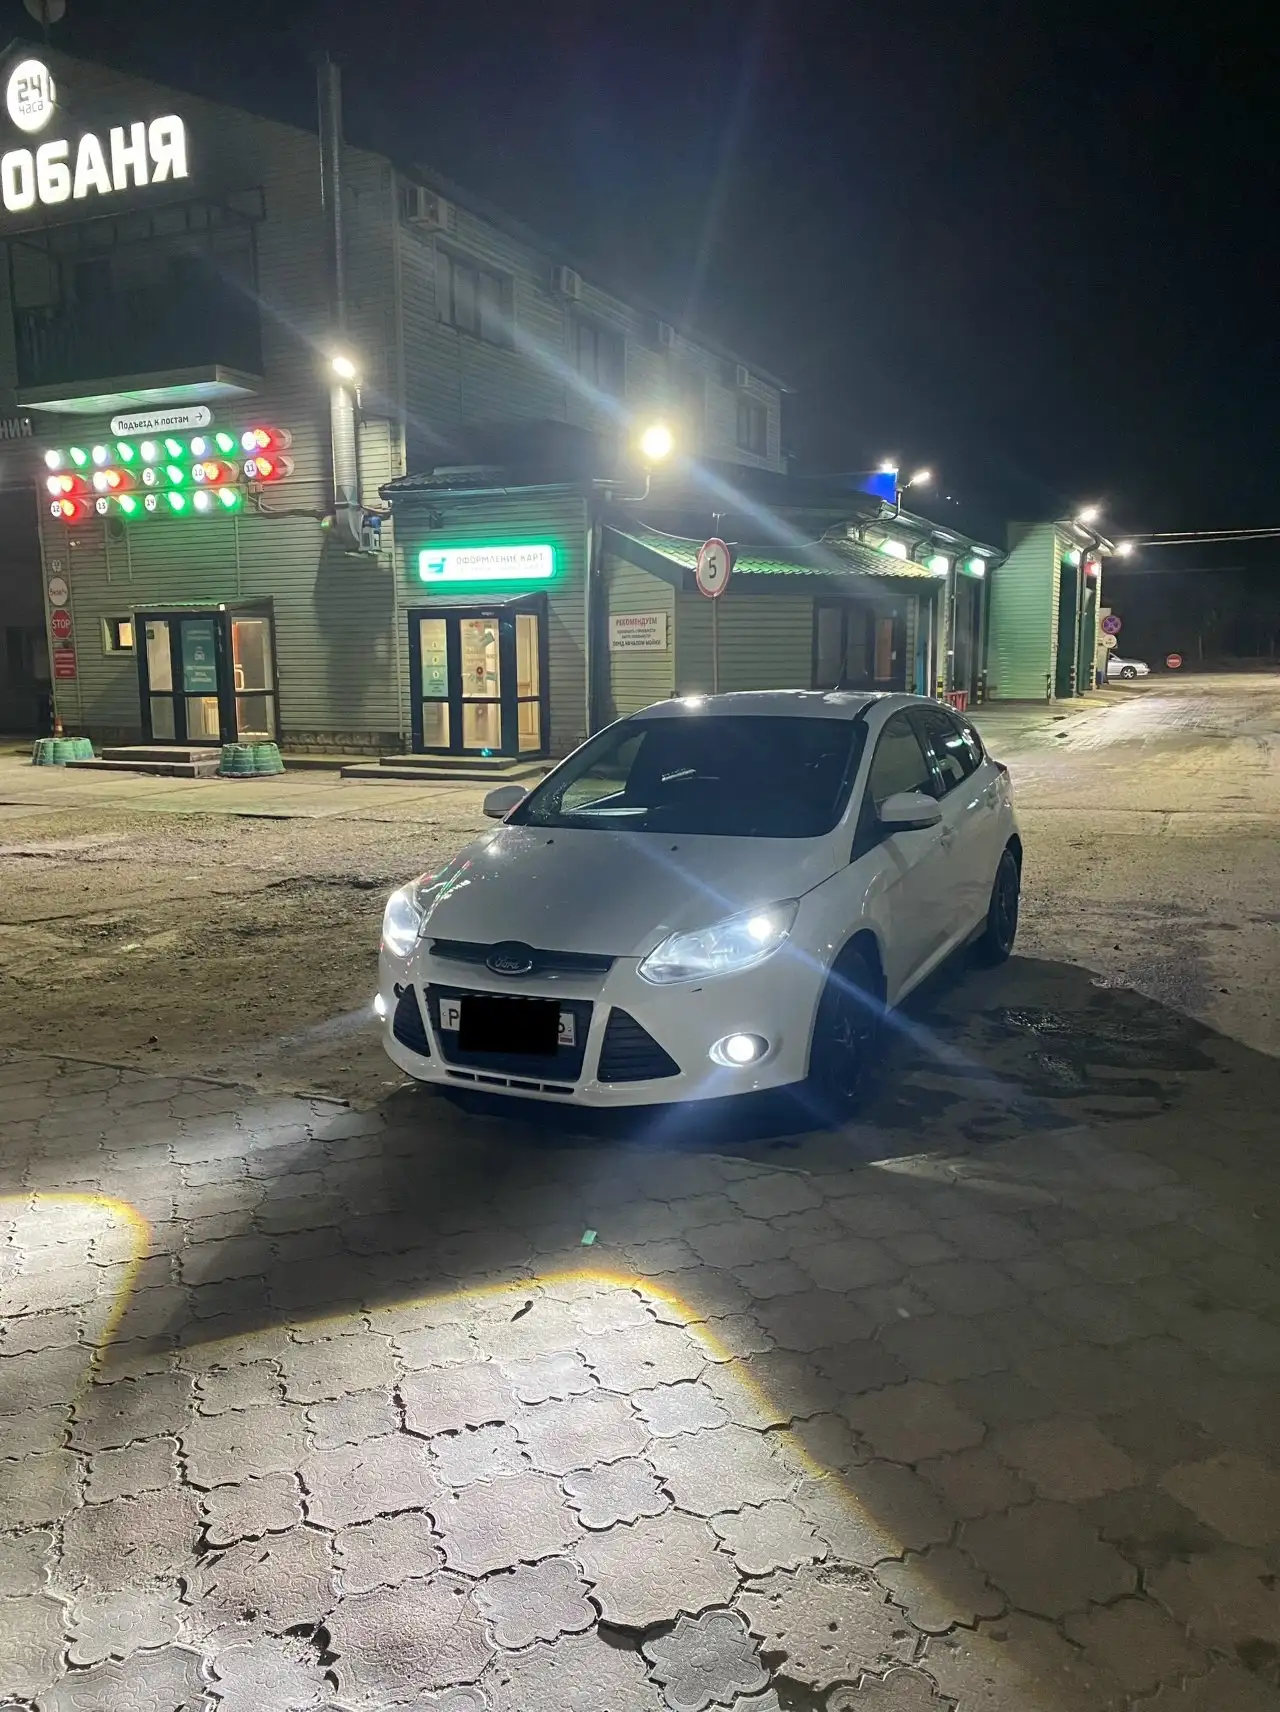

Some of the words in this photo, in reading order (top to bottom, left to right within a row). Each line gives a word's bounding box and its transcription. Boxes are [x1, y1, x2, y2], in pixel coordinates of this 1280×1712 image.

[17, 74, 43, 103] 24
[18, 101, 44, 115] часа
[1, 115, 189, 213] ОБАНЯ
[118, 420, 153, 431] Подъезд
[154, 418, 160, 426] к
[161, 415, 189, 425] постам
[456, 554, 517, 565] ОФОРМЛЕНИЕ
[520, 553, 544, 562] КАРТ
[709, 556, 717, 579] 5
[52, 619, 71, 629] STOP
